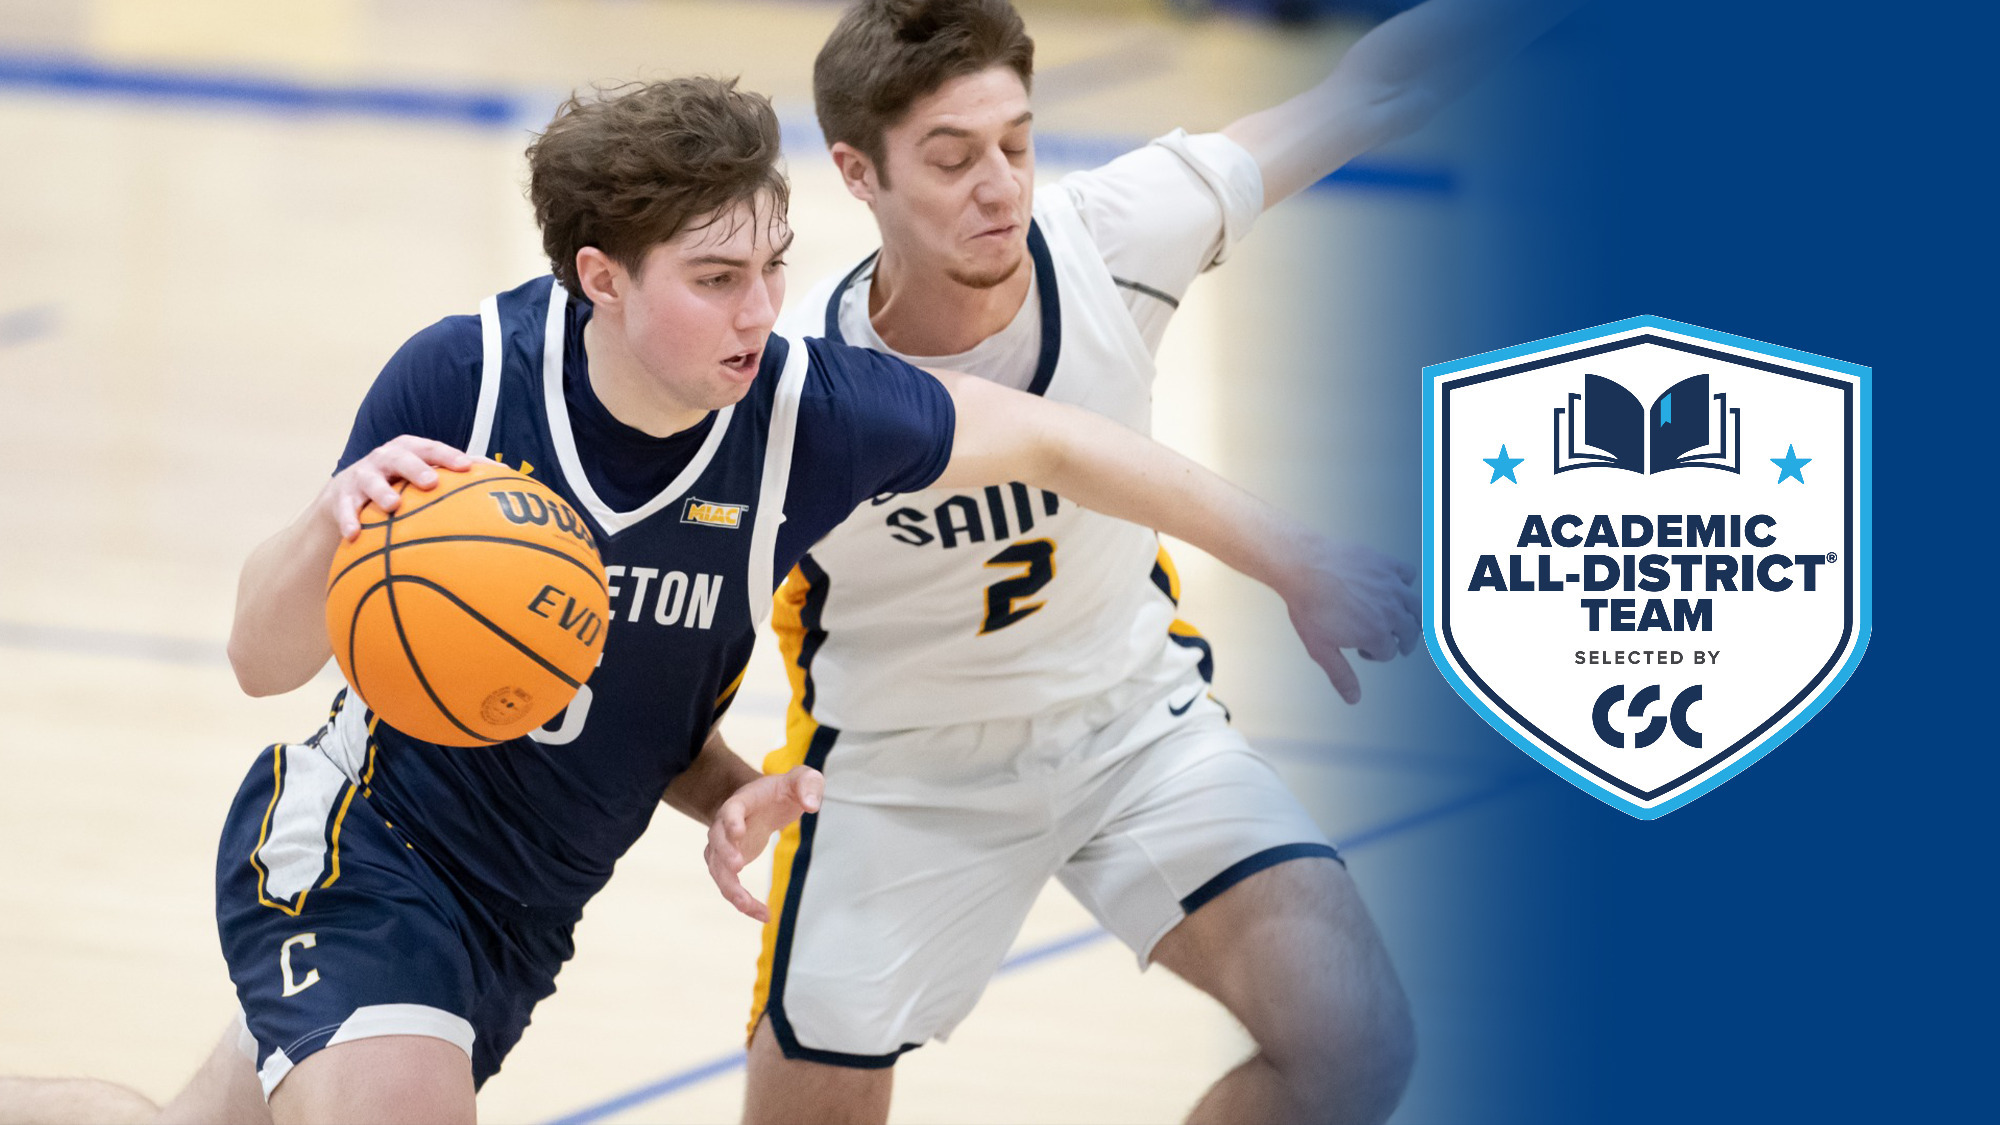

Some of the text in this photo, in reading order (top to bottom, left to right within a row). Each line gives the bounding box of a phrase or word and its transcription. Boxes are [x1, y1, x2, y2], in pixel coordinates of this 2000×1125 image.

[687, 503, 738, 525] MIAC
[976, 537, 1056, 636] 2
[280, 932, 321, 998] C
